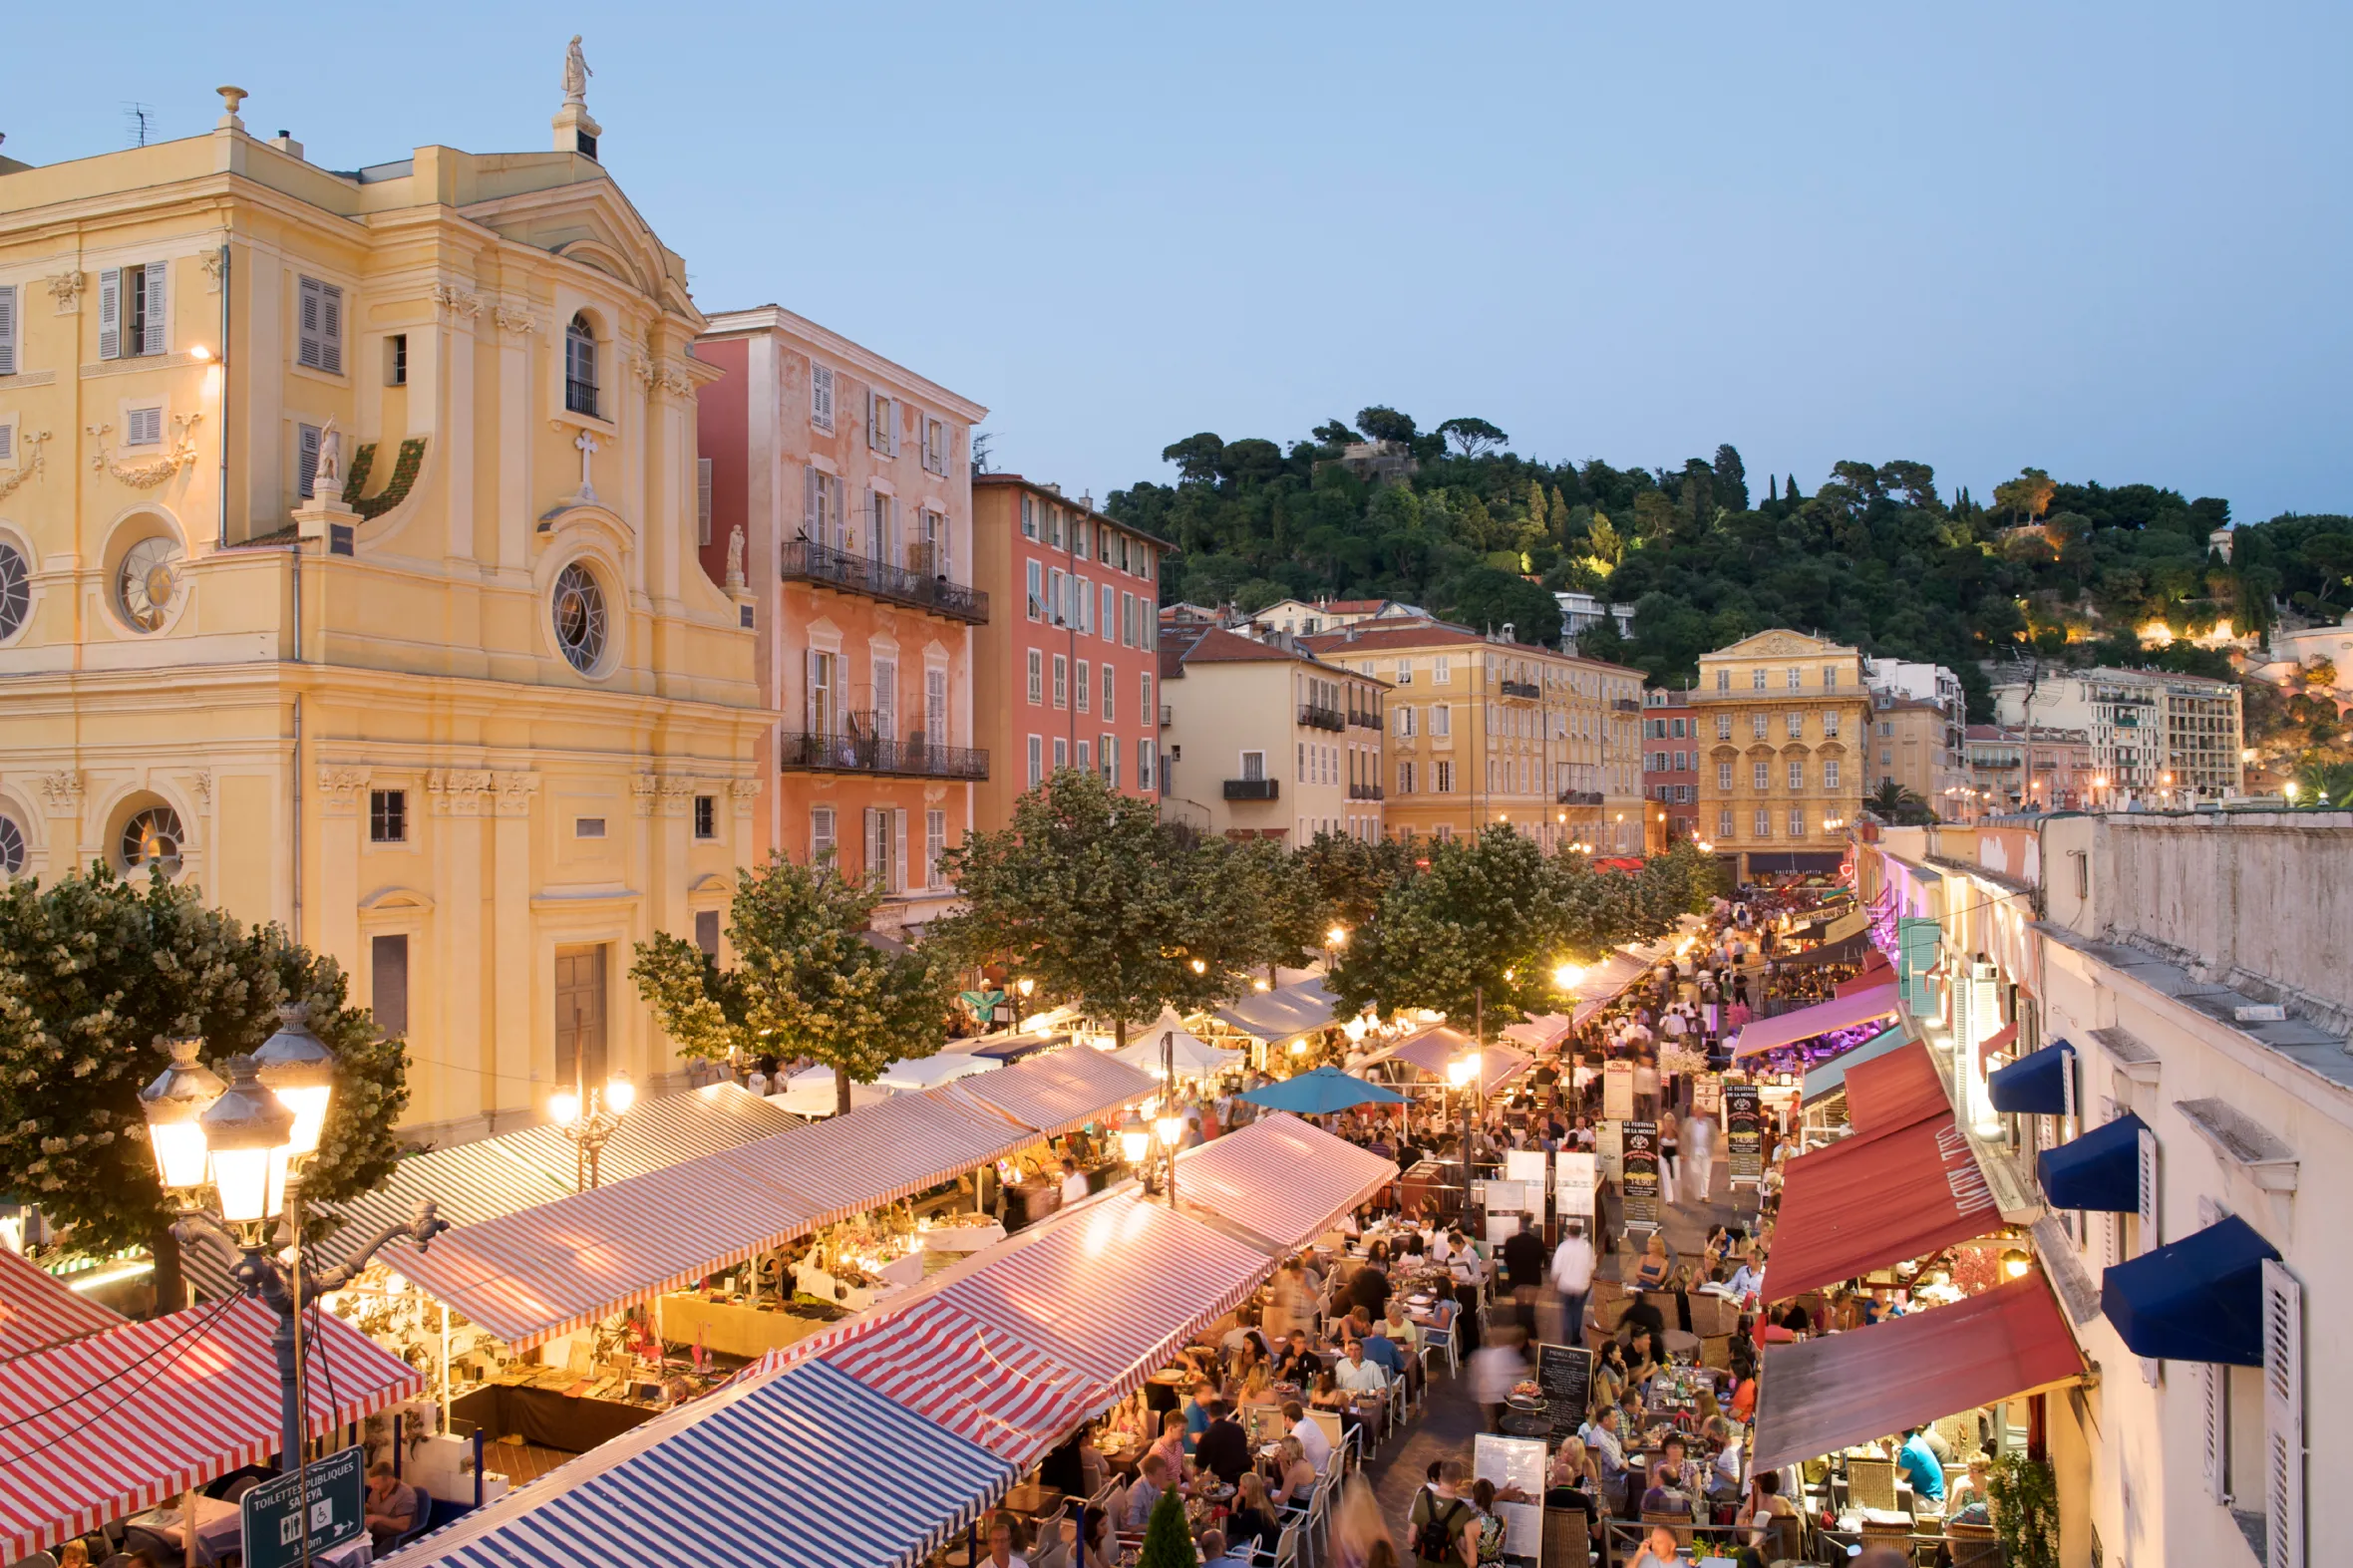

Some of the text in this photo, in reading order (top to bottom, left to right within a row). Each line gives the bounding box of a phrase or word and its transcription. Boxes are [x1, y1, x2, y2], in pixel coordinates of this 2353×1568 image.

[254, 1461, 354, 1511] TOILETTES PUBLIQUES
[288, 1486, 323, 1510] SAEYA
